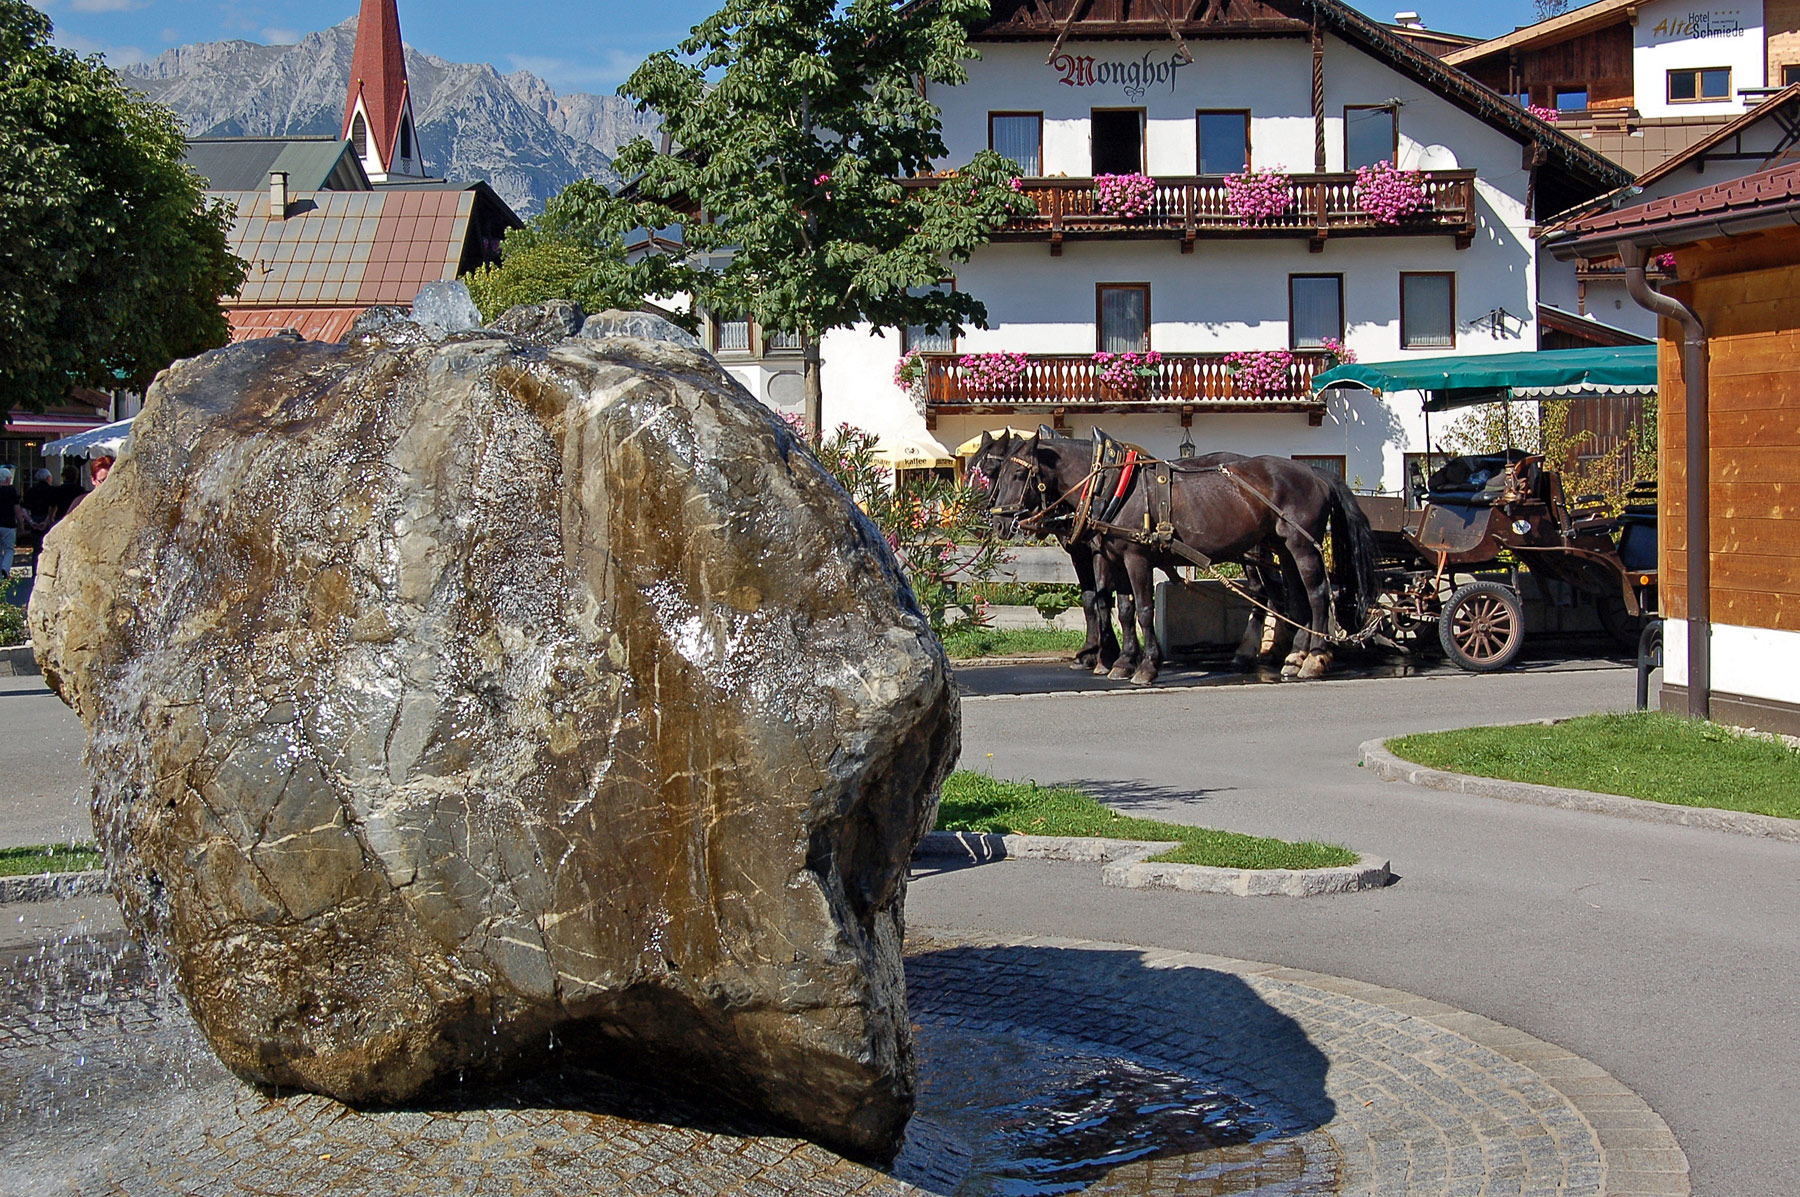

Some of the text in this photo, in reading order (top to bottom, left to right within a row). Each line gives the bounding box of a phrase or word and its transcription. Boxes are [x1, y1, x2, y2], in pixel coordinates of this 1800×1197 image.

[1653, 17, 1744, 39] Alte Schmiede
[1689, 11, 1709, 24] Hotel
[1054, 49, 1189, 102] Monghof
